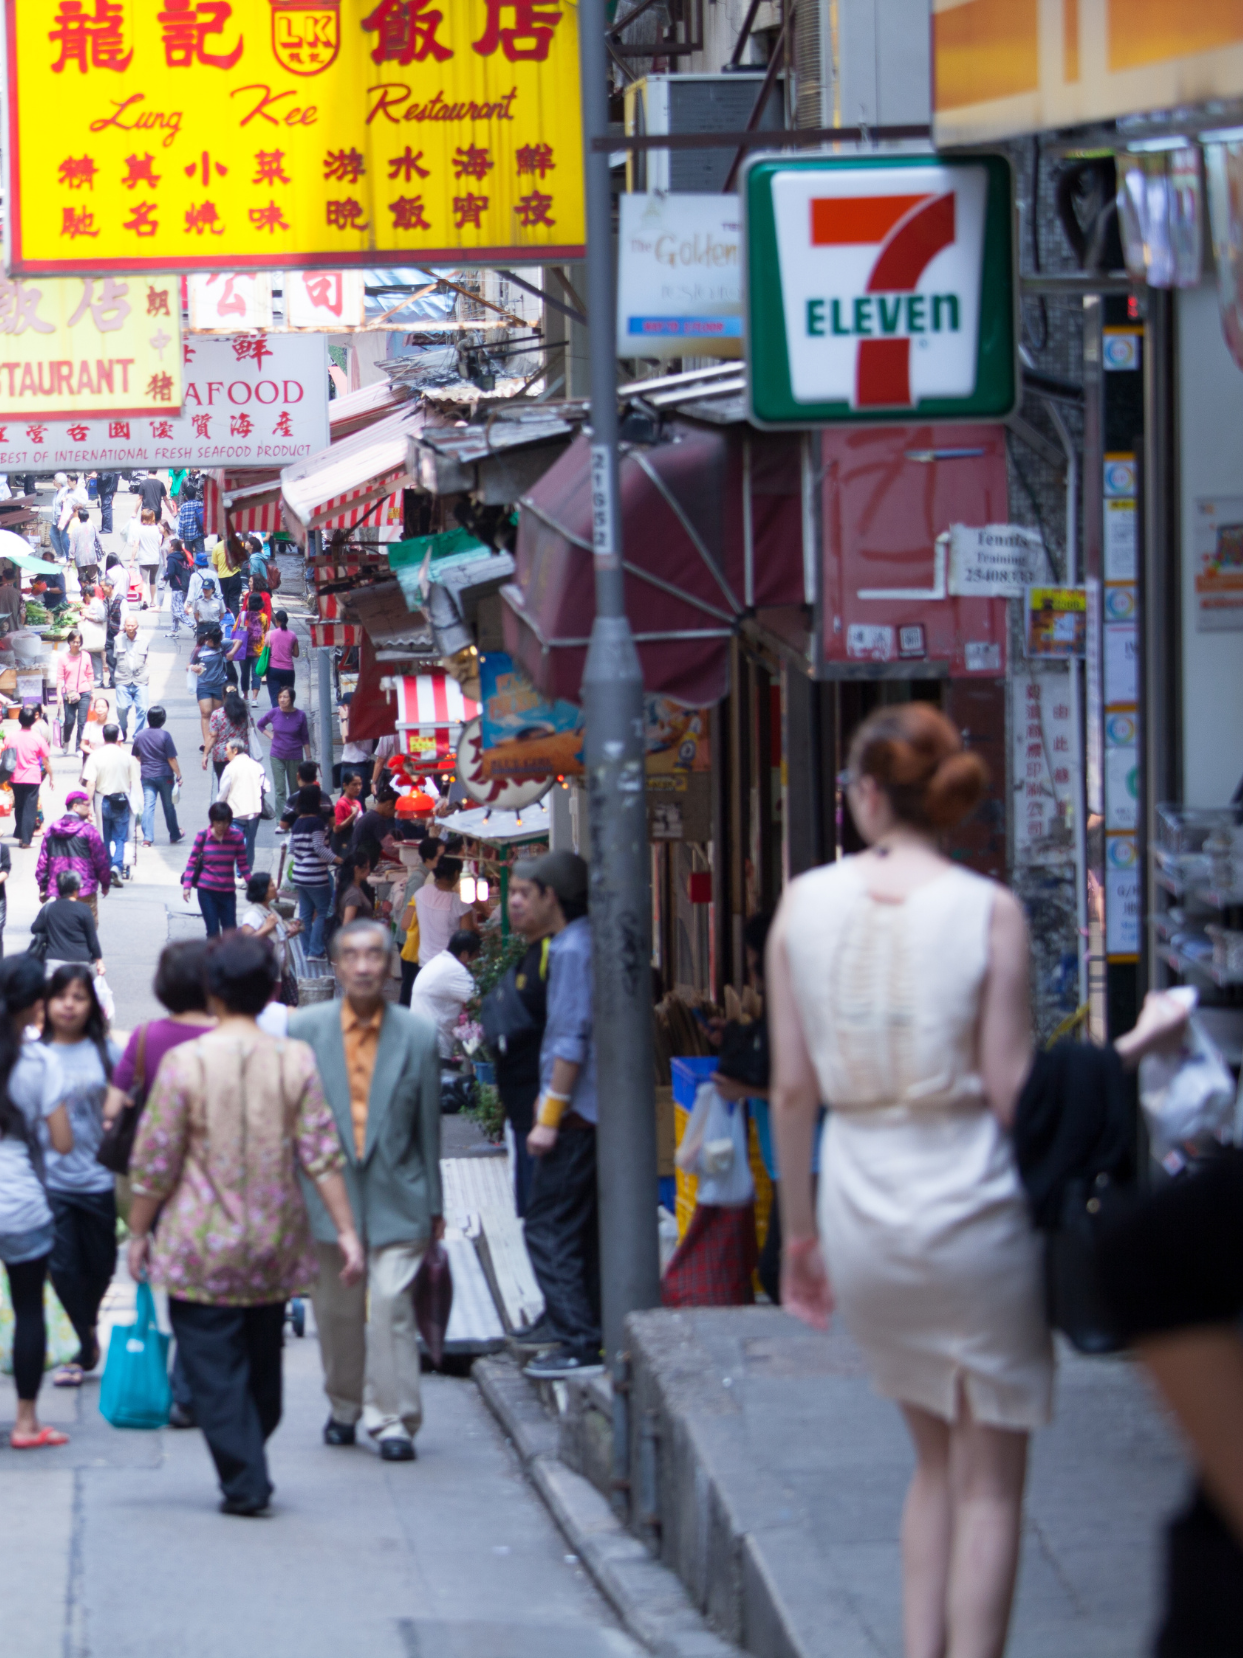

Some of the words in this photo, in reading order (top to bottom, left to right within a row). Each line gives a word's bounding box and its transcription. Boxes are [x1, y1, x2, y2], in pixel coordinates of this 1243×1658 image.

[48, 0, 244, 74] 龍記
[278, 16, 335, 48] LK
[360, 0, 564, 66] 飯店
[89, 93, 183, 148] Lung
[230, 84, 319, 127] Kee
[365, 83, 518, 125] Restaurant
[184, 380, 305, 407] AFOOD
[0, 451, 28, 464] BEST
[33, 451, 50, 463] OF
[54, 447, 150, 463] INTERNATIONAL
[155, 447, 193, 460] FRESH
[197, 445, 252, 459] SEAFOOD
[256, 444, 312, 458] PRODUCT
